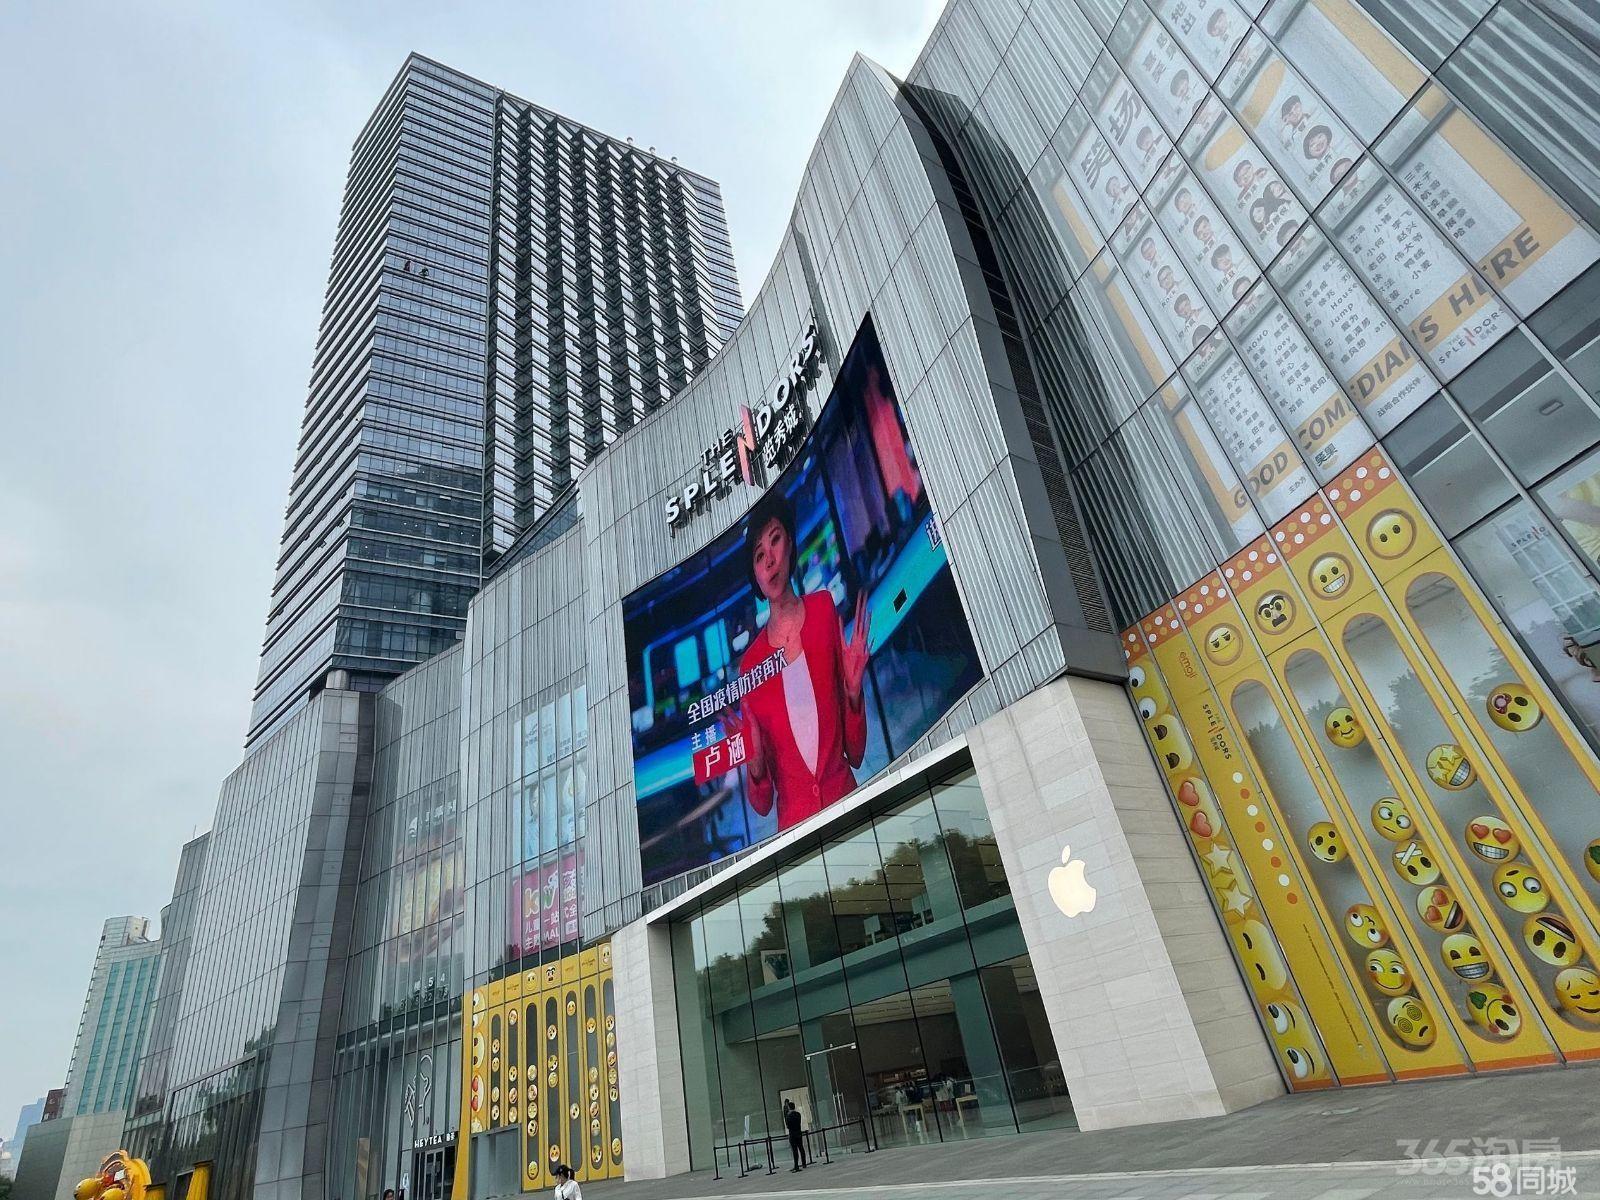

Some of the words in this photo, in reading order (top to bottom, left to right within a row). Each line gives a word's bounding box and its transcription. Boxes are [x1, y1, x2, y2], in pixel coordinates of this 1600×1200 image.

[1328, 300, 1355, 329] Jump
[1245, 327, 1269, 354] MOMO
[1272, 334, 1291, 356] Joey
[666, 325, 816, 523] SPLENDORS
[701, 428, 735, 465] THE
[1179, 651, 1197, 679] emoji
[688, 648, 787, 724] 全国疫情防控再次
[692, 725, 716, 750] 主播
[705, 732, 746, 777] 卢涵
[414, 1135, 442, 1148] HEYTEA
